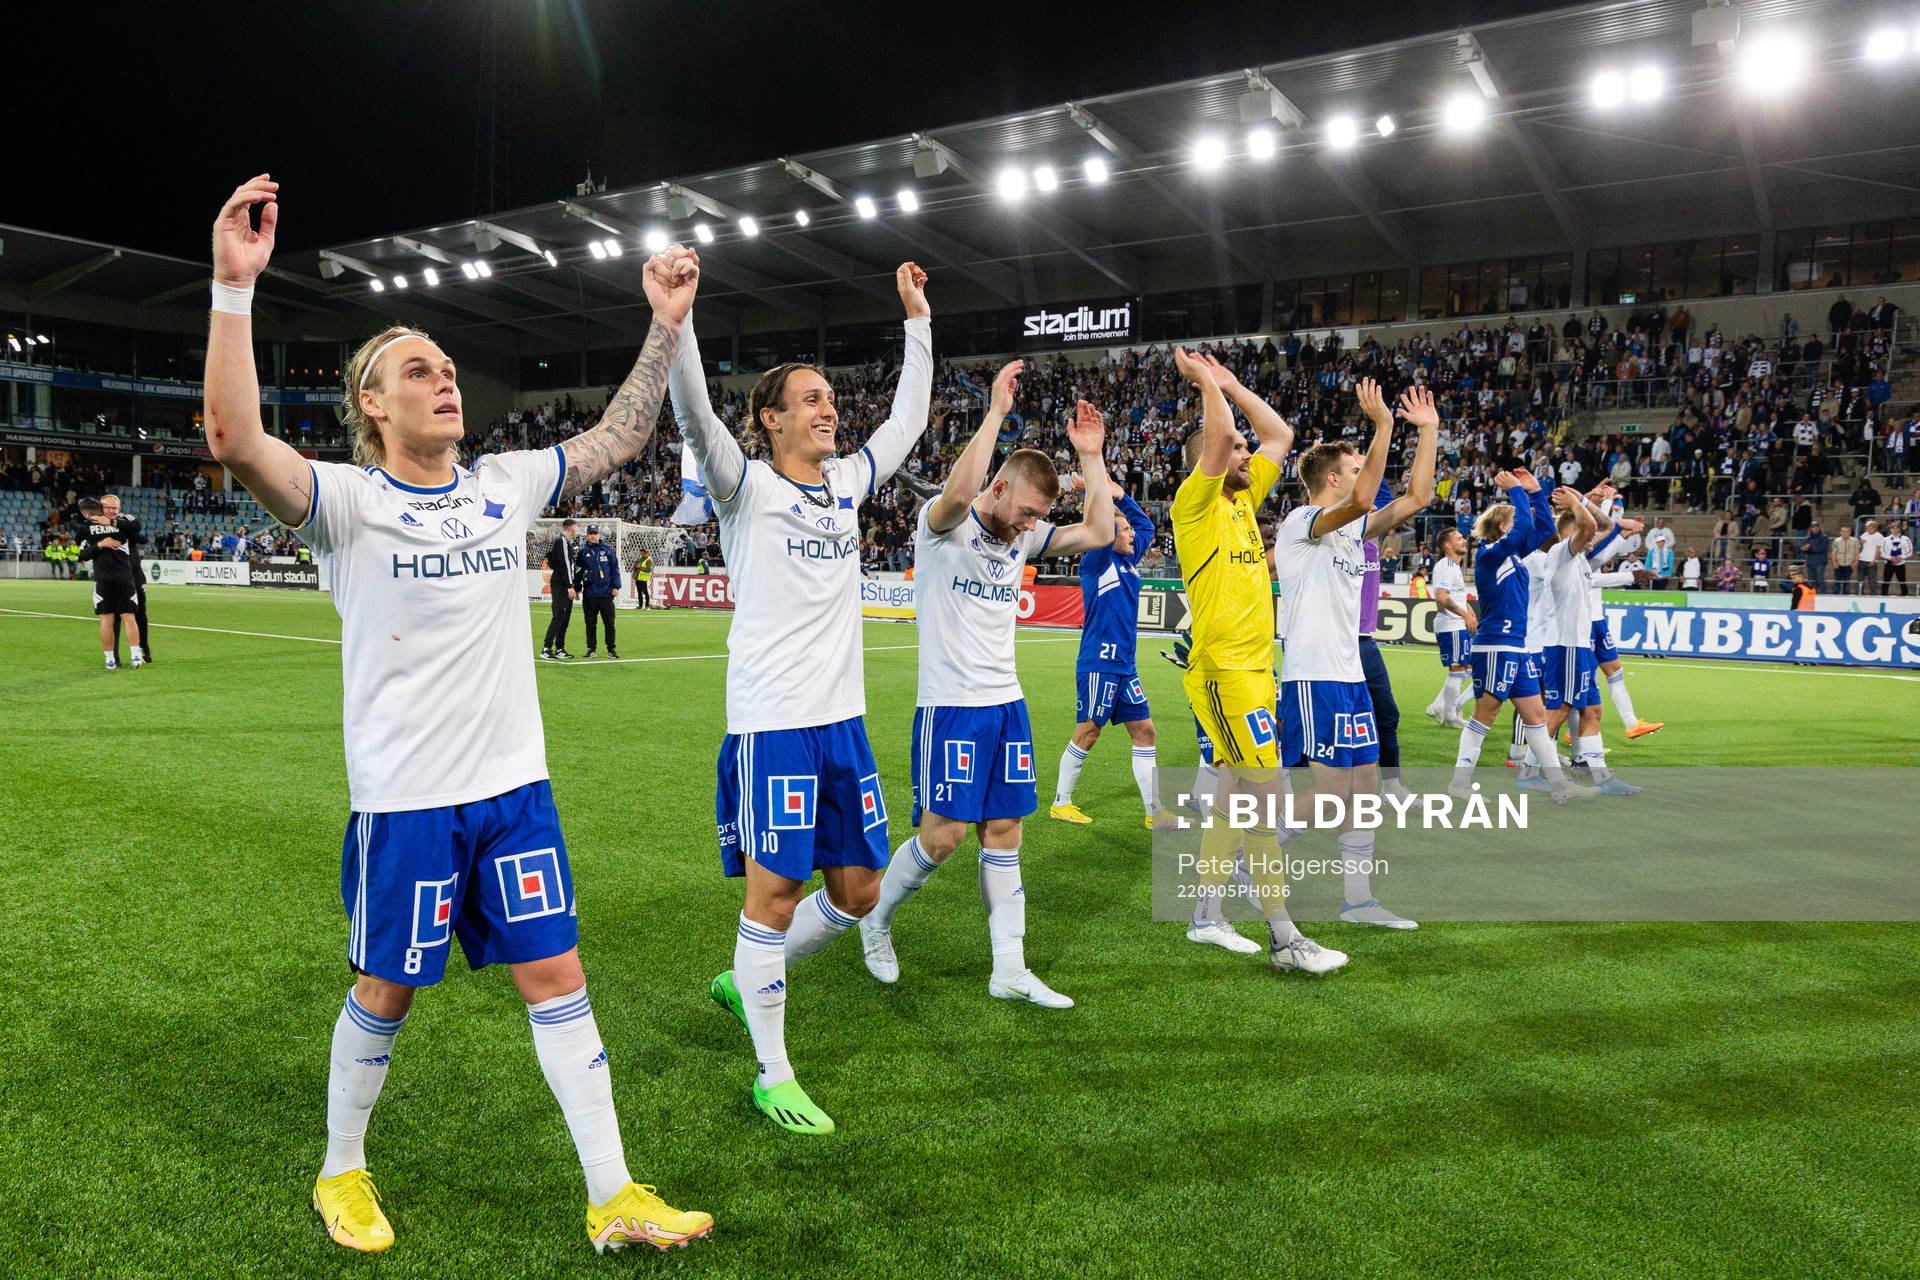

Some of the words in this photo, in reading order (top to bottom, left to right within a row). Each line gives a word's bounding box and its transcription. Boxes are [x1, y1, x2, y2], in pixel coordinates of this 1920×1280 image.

[1024, 306, 1130, 336] stadium
[1063, 332, 1077, 342] Join
[1078, 331, 1089, 341] the
[1090, 328, 1129, 340] movement
[166, 446, 191, 455] pepsi
[393, 545, 519, 578] HOLMEN
[195, 566, 238, 580] HOLMEN
[251, 569, 283, 583] stadium
[284, 571, 317, 585] stadium
[952, 575, 1019, 603] HOLMEN
[1100, 642, 1117, 660] 21
[1317, 743, 1335, 760] 24
[935, 783, 953, 802] 21
[761, 830, 779, 854] 10
[404, 947, 423, 975] 8
